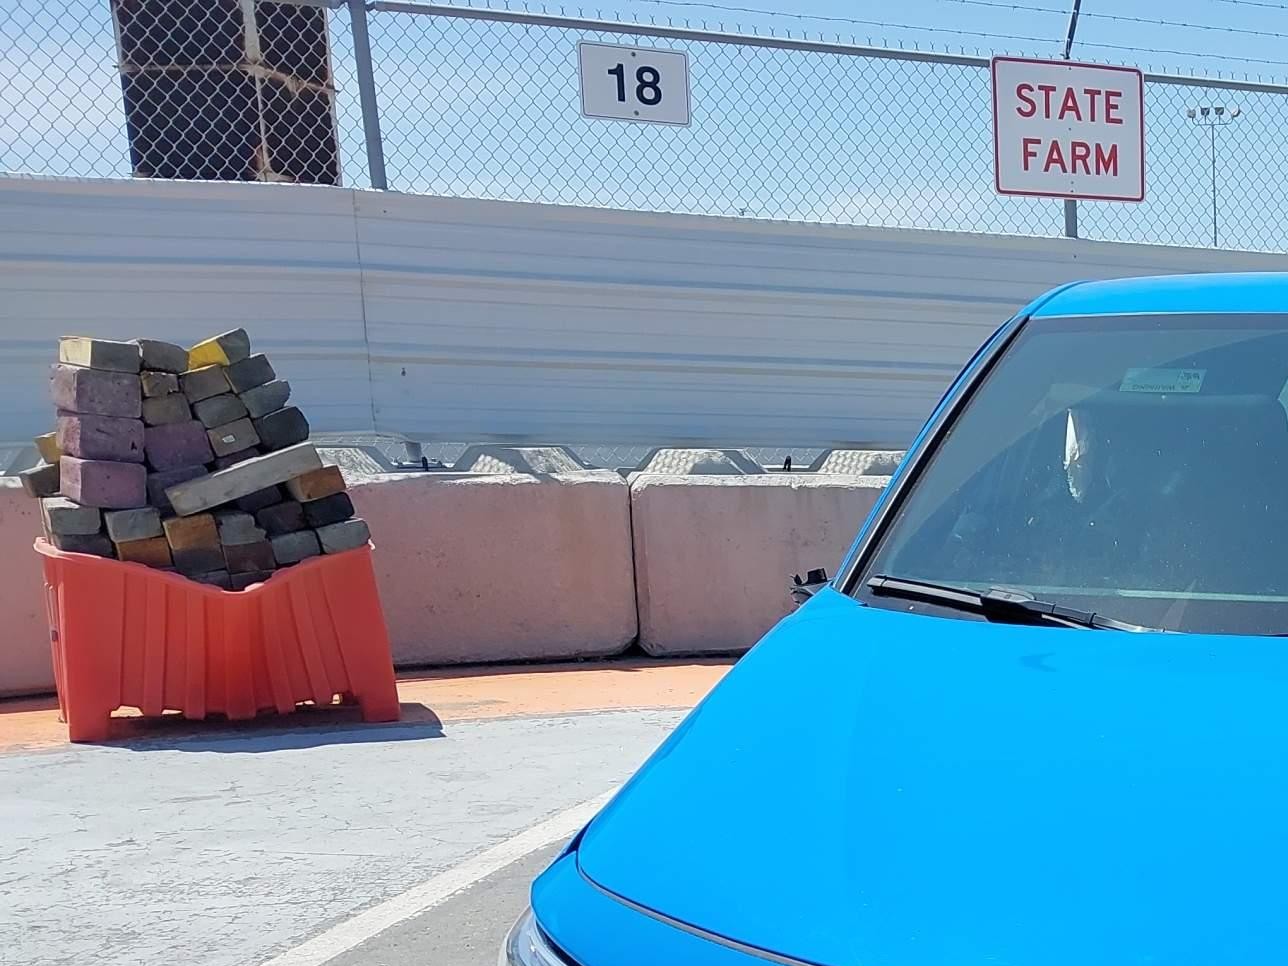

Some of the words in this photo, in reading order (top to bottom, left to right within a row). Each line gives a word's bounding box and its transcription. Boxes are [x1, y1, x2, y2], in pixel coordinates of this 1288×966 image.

[607, 62, 662, 105] 18
[1015, 82, 1124, 125] STATE
[1022, 137, 1119, 177] FARM
